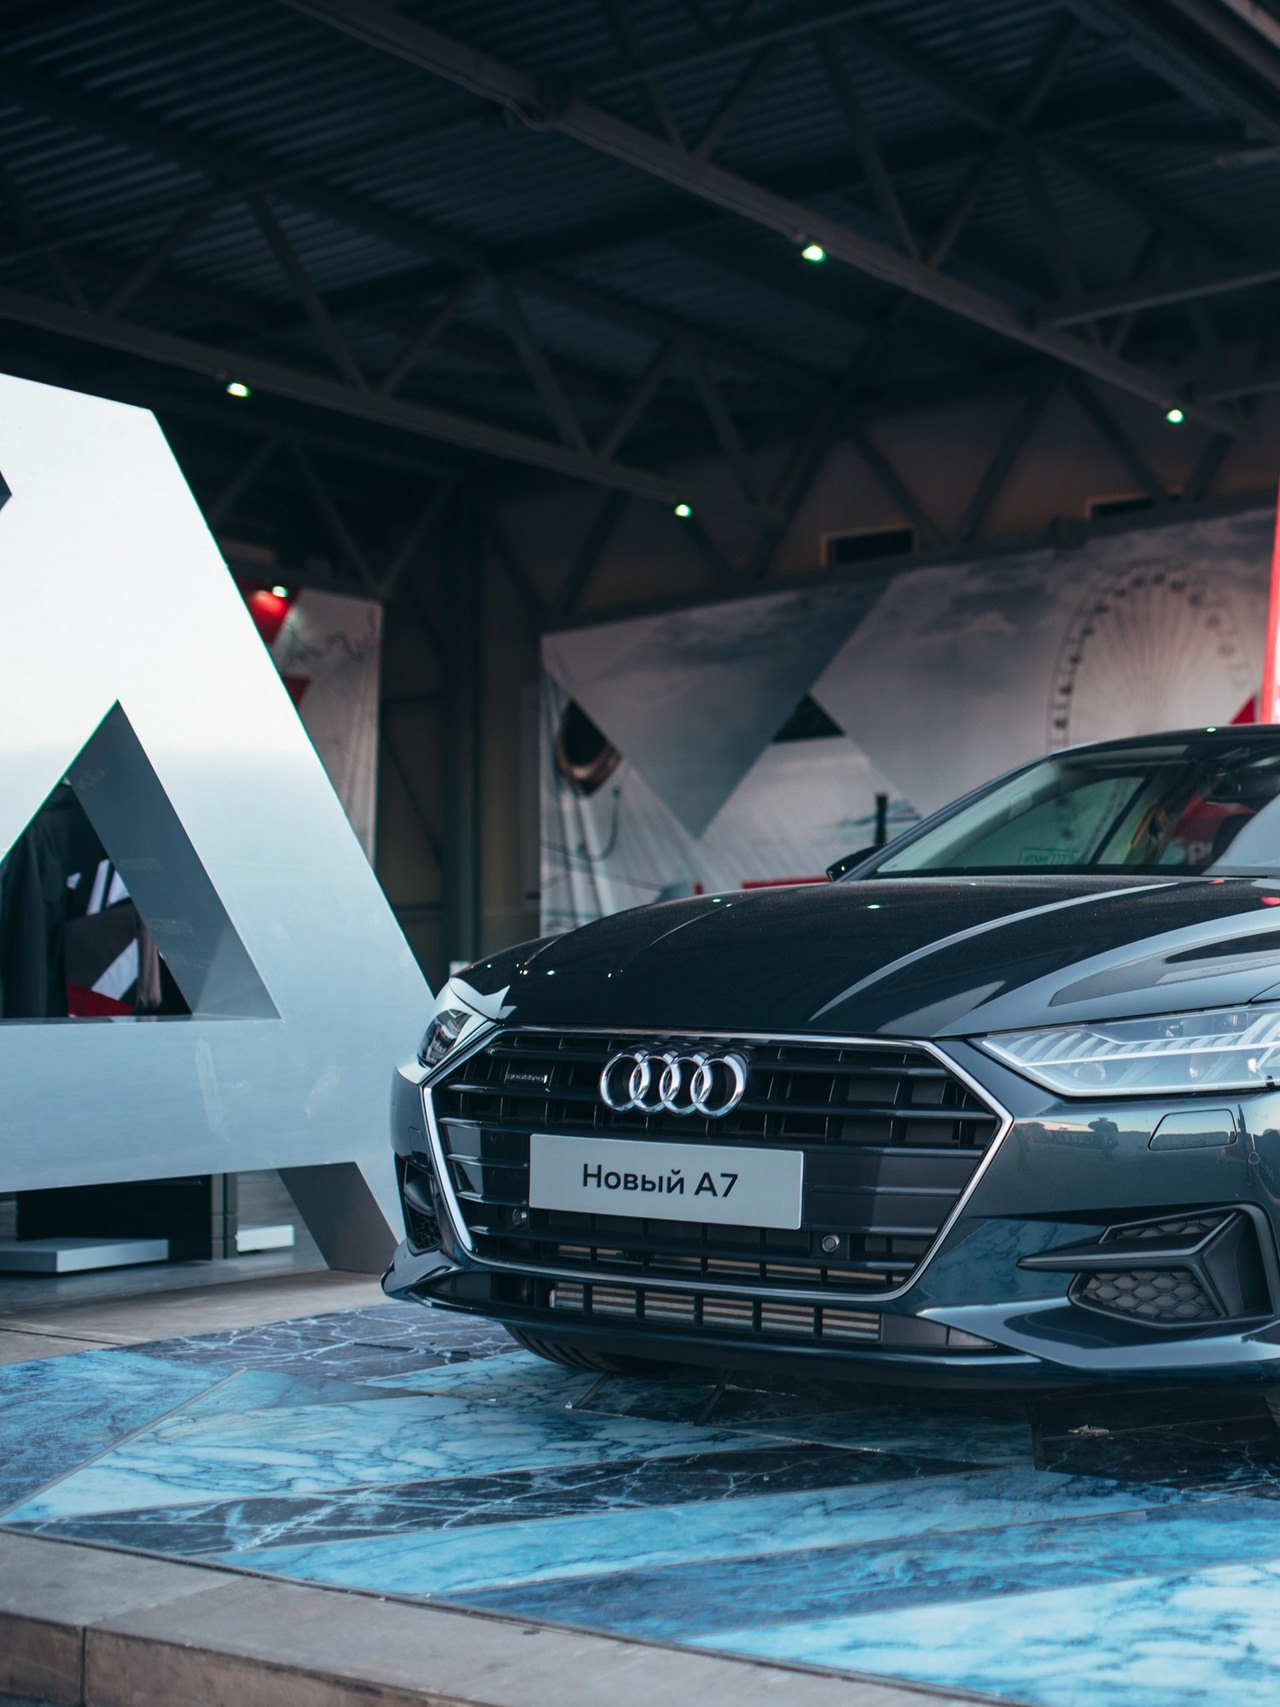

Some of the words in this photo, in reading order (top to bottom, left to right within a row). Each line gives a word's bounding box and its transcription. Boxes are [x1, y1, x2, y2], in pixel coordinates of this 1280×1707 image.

[505, 1073, 544, 1082] quattro
[582, 1163, 685, 1196] Новый
[693, 1172, 739, 1199] A7
